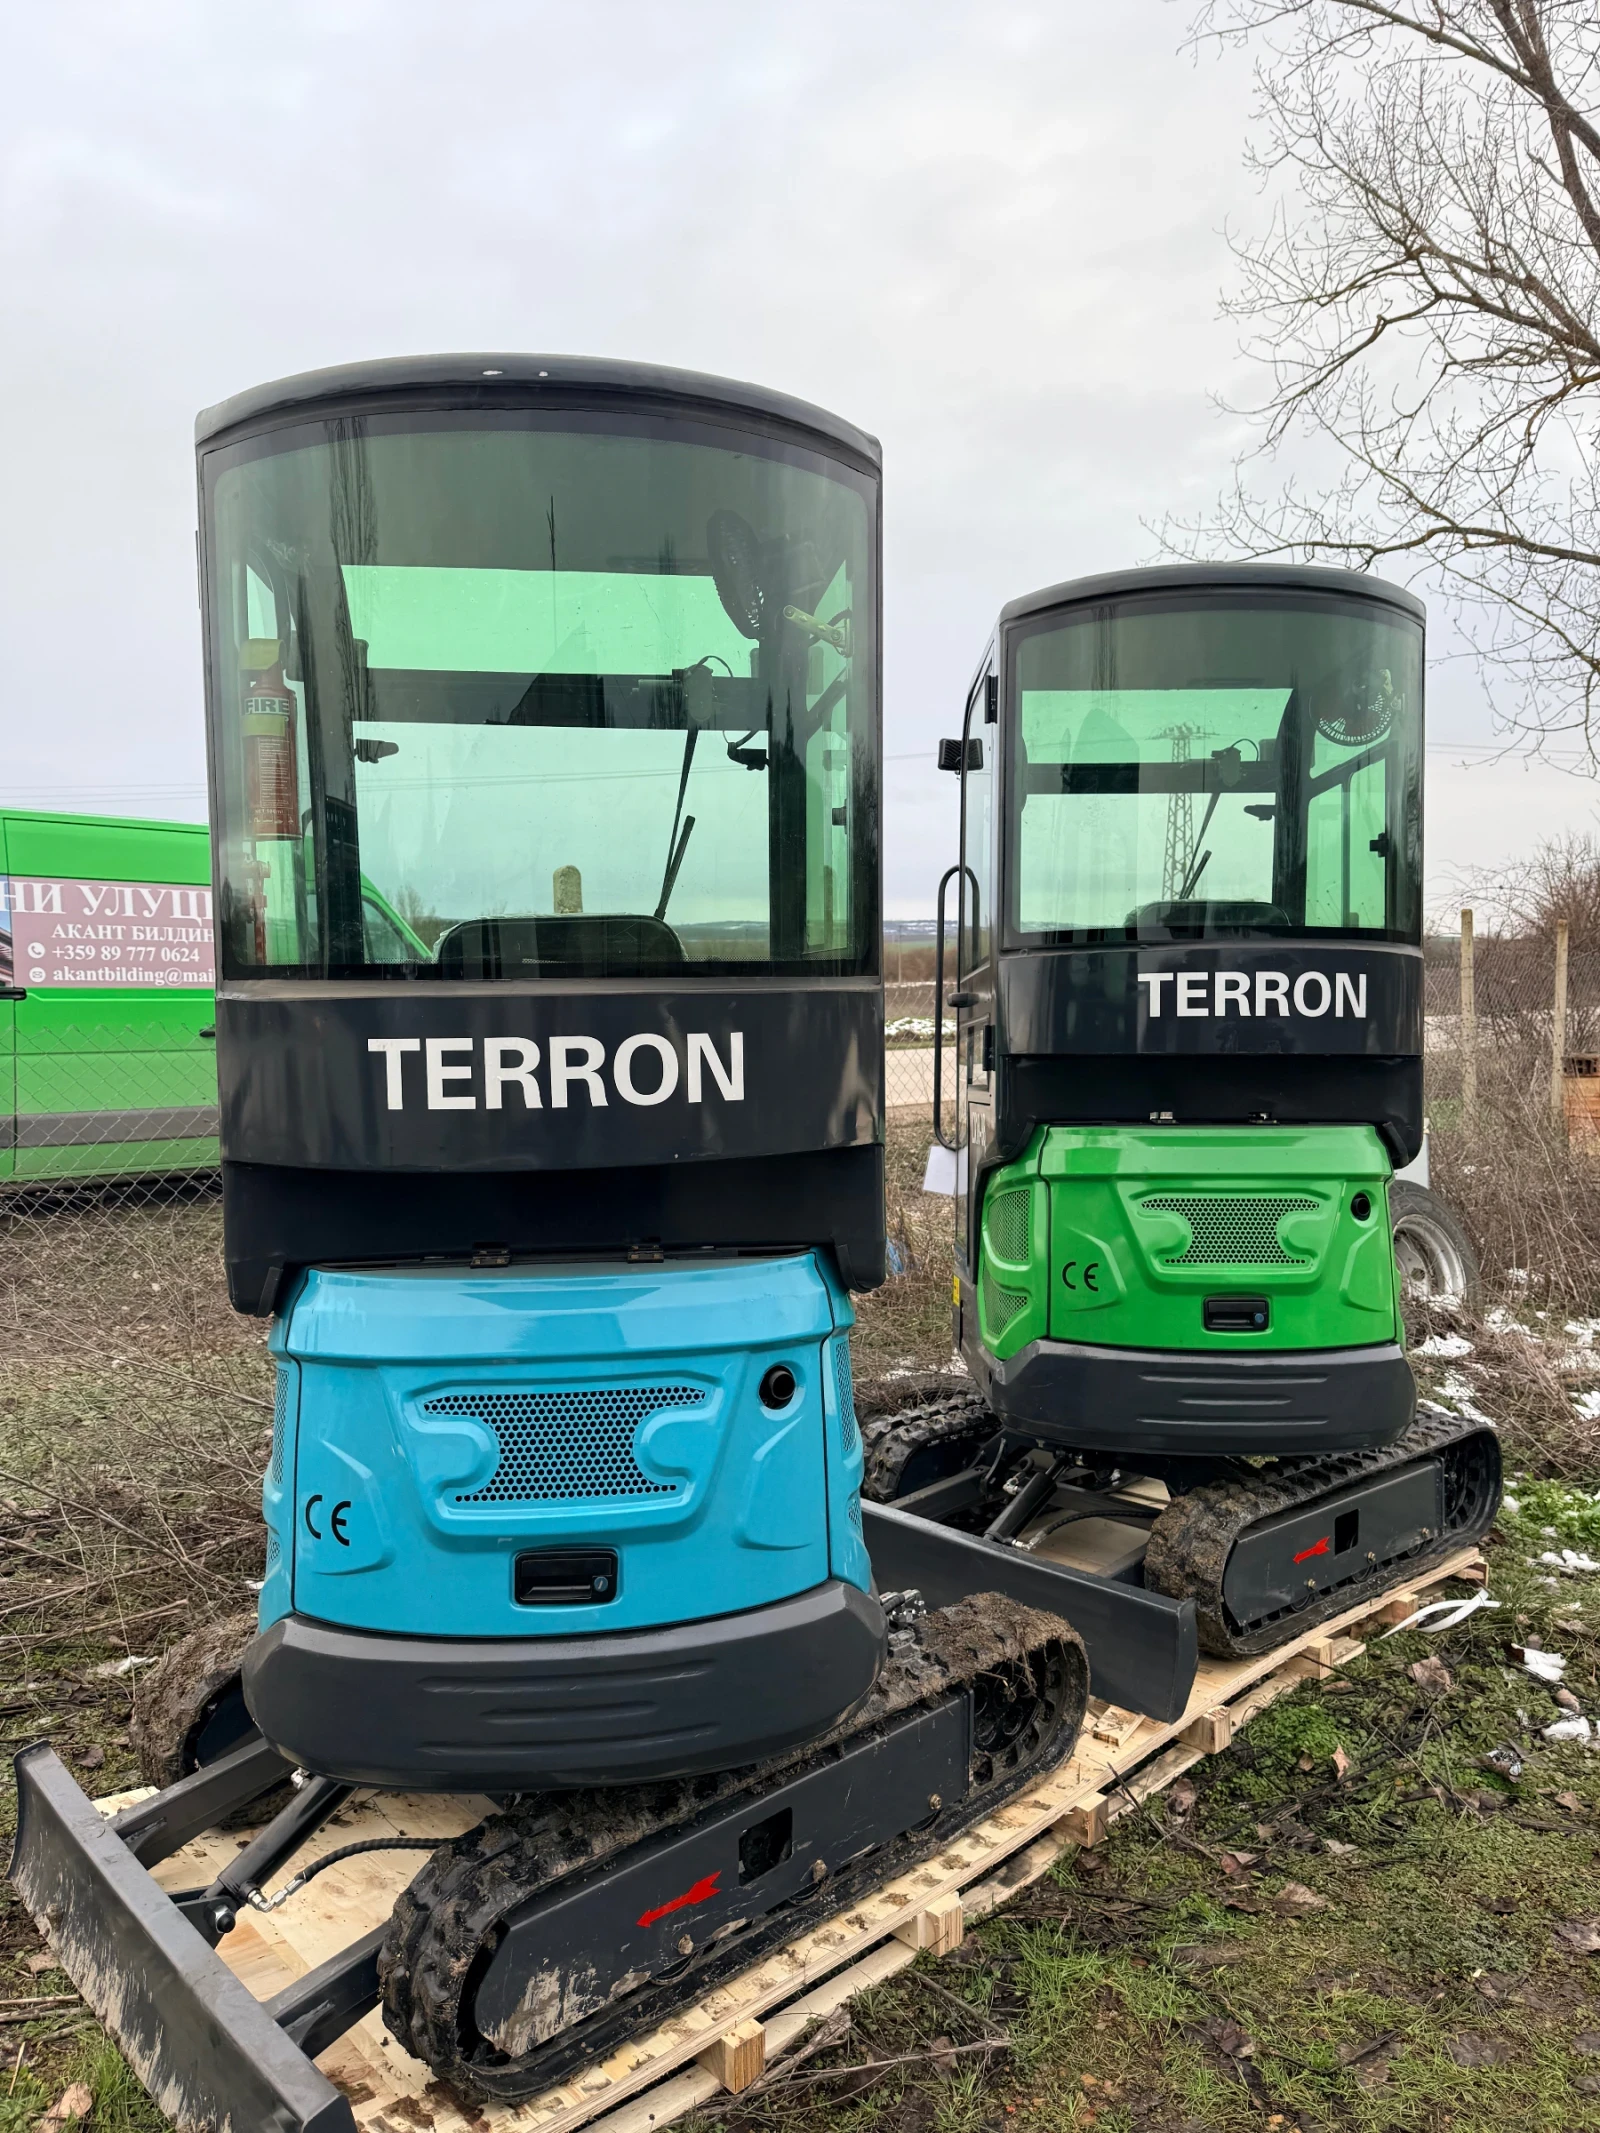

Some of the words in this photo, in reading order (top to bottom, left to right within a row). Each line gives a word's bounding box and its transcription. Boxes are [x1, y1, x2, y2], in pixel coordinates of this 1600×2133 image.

[245, 698, 290, 715] FIRE
[51, 923, 127, 941] АКАНТ
[52, 944, 96, 961] +359
[100, 946, 122, 961] 89
[126, 946, 156, 962] 777
[161, 946, 201, 962] 0624
[1137, 971, 1367, 1019] TERRON
[367, 1031, 745, 1110] TERRON
[1062, 1261, 1099, 1292] CE
[305, 1494, 352, 1547] CE
